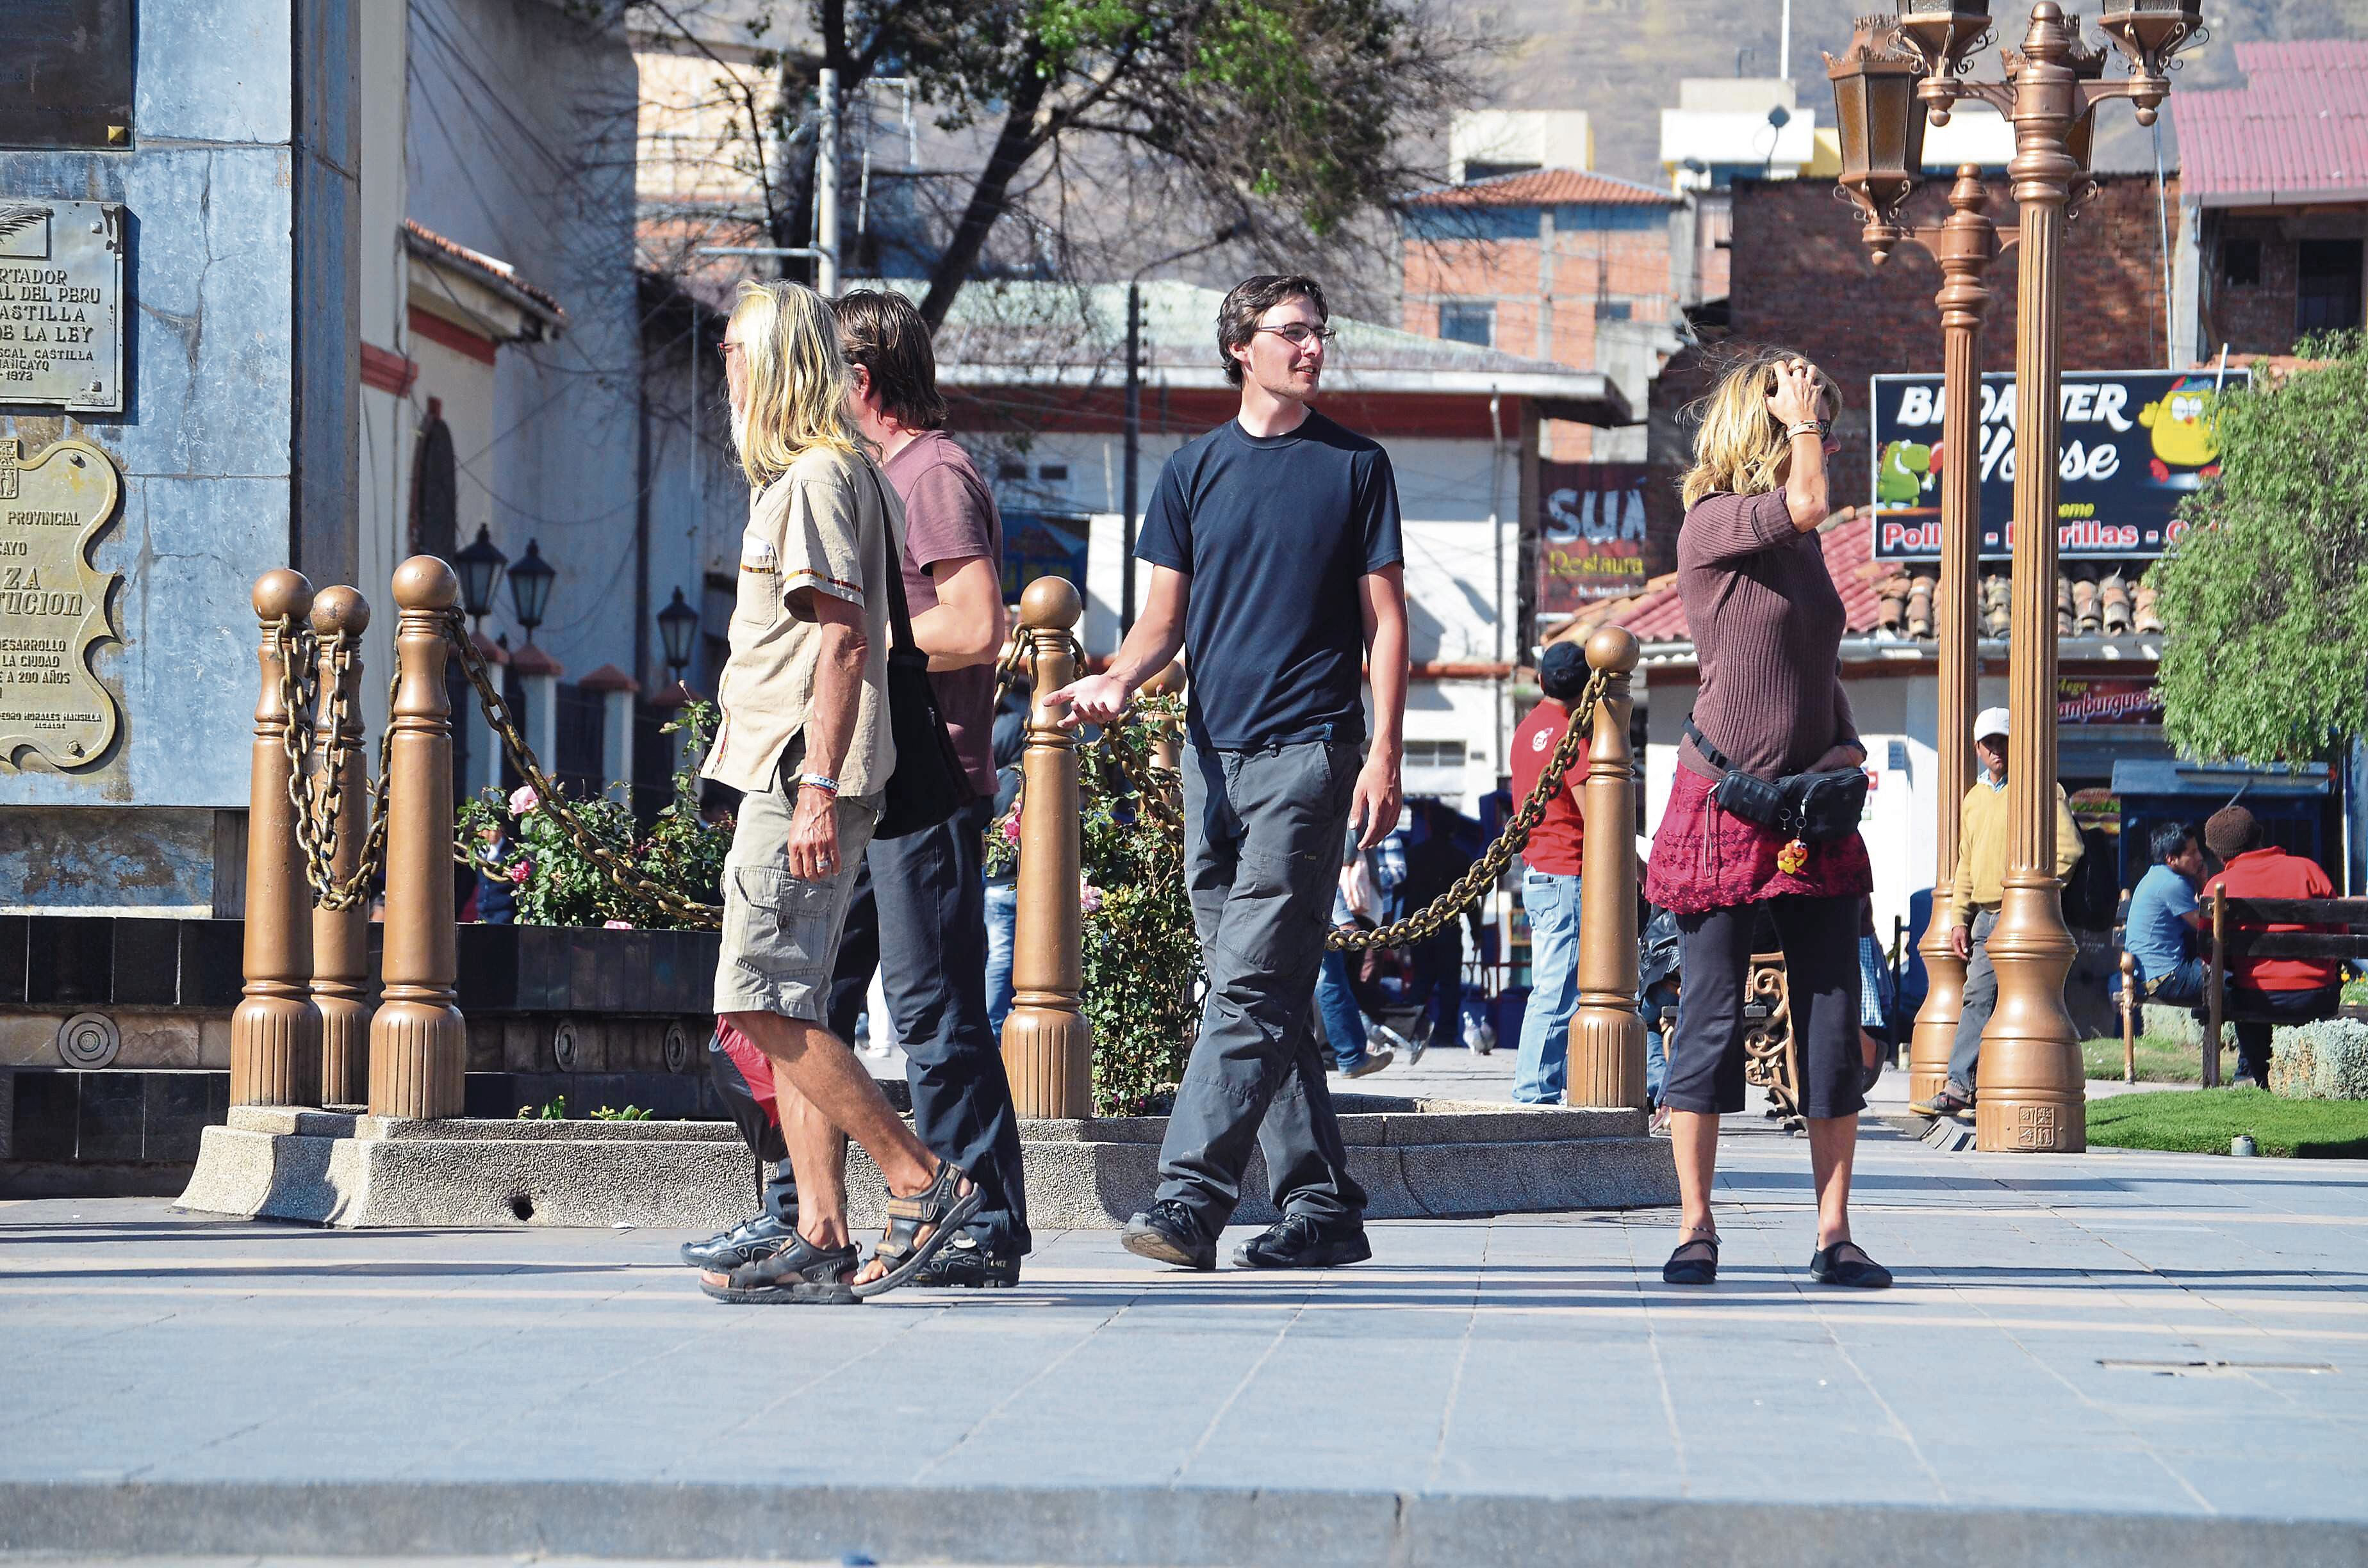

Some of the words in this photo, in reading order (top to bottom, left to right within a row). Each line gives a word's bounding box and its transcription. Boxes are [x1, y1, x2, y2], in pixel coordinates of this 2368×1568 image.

[20, 286, 53, 302] DEL
[56, 287, 101, 304] PERU
[21, 325, 47, 342] LA
[54, 326, 94, 344] LEY
[34, 348, 94, 361] CASTILLA
[6, 510, 81, 527] PROVINCIAL
[3, 655, 16, 667] LA
[20, 655, 60, 667] CIUDAD
[17, 671, 39, 684] 200
